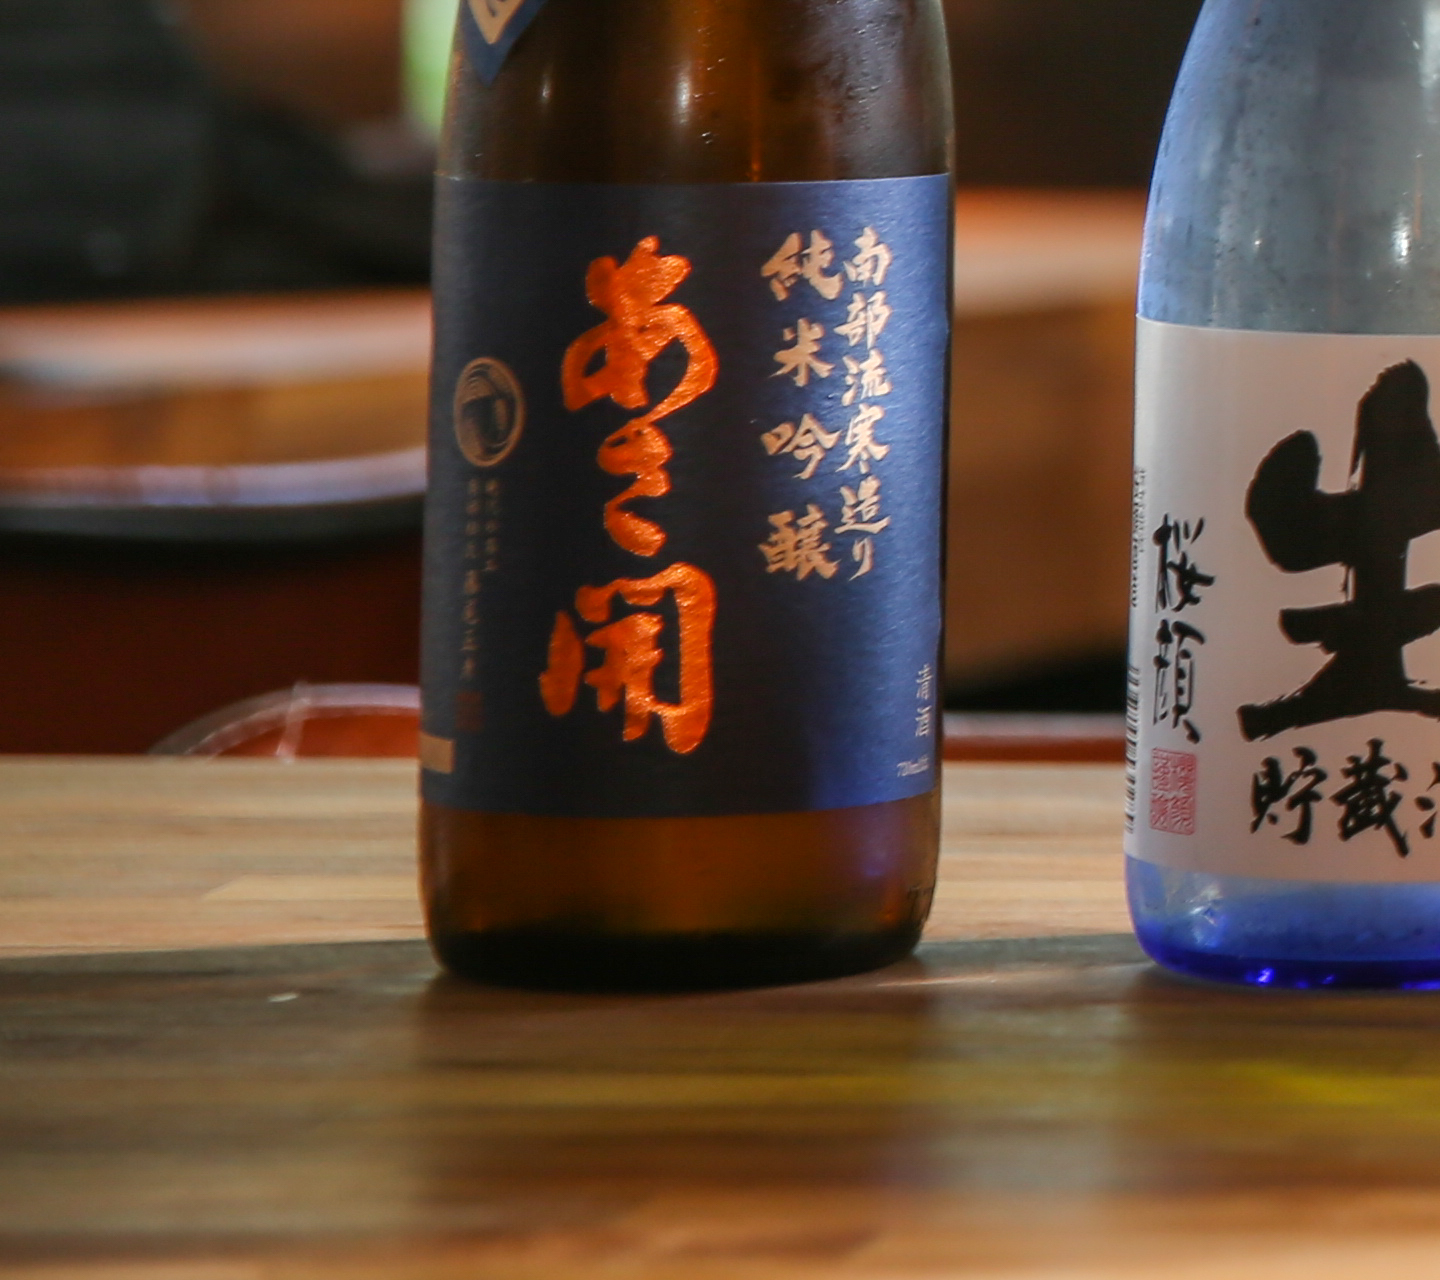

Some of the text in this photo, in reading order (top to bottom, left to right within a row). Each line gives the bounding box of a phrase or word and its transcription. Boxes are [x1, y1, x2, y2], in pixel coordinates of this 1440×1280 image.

[758, 228, 844, 582] 純米吟醸
[834, 225, 894, 582] 南部流寒造り
[1152, 512, 1215, 744] 桜顔
